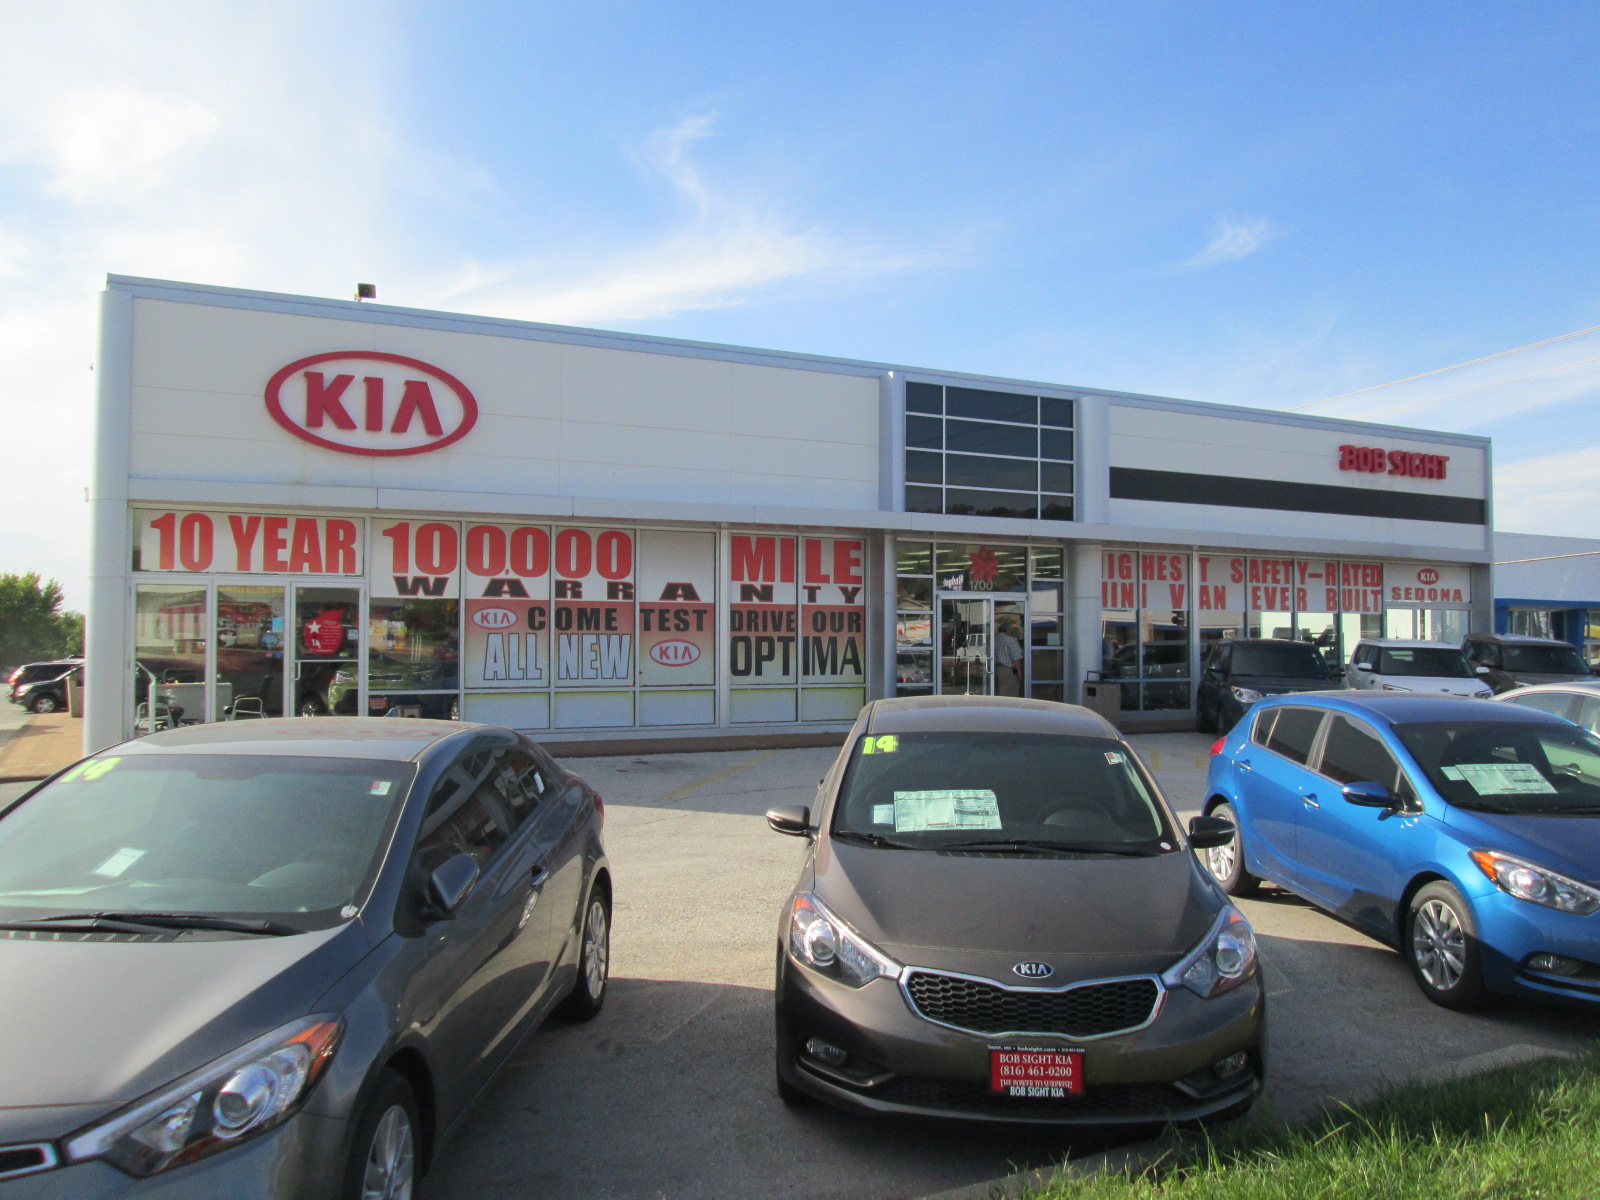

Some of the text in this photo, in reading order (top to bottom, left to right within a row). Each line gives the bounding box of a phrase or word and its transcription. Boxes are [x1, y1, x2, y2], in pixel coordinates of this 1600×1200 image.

[304, 371, 443, 436] KIA
[1339, 445, 1449, 479] BOB SIGHT
[150, 512, 862, 584] 10 YEAR 100,000 MILE
[1102, 553, 1211, 582] IGHEST
[1420, 571, 1437, 582] KIA
[393, 575, 862, 604] WARRANTY
[970, 580, 993, 591] 1700
[1391, 587, 1464, 602] SEDONA
[1168, 583, 1227, 611] VAN
[1251, 585, 1307, 611] EVER
[1325, 587, 1382, 612] BUILT
[480, 612, 515, 625] KIA
[527, 606, 862, 633] COME TEST DRIVE OUR
[483, 633, 631, 681] ALL NEW
[658, 645, 694, 660] KIA
[730, 635, 863, 677] OPTIMA
[862, 735, 898, 755] 14
[1020, 963, 1048, 975] KIA
[1000, 1054, 1073, 1065] BOB SIGHT KIA
[1000, 1065, 1072, 1077] (816) 461-0200
[1010, 1086, 1065, 1098] BOB SIGHT KIA
